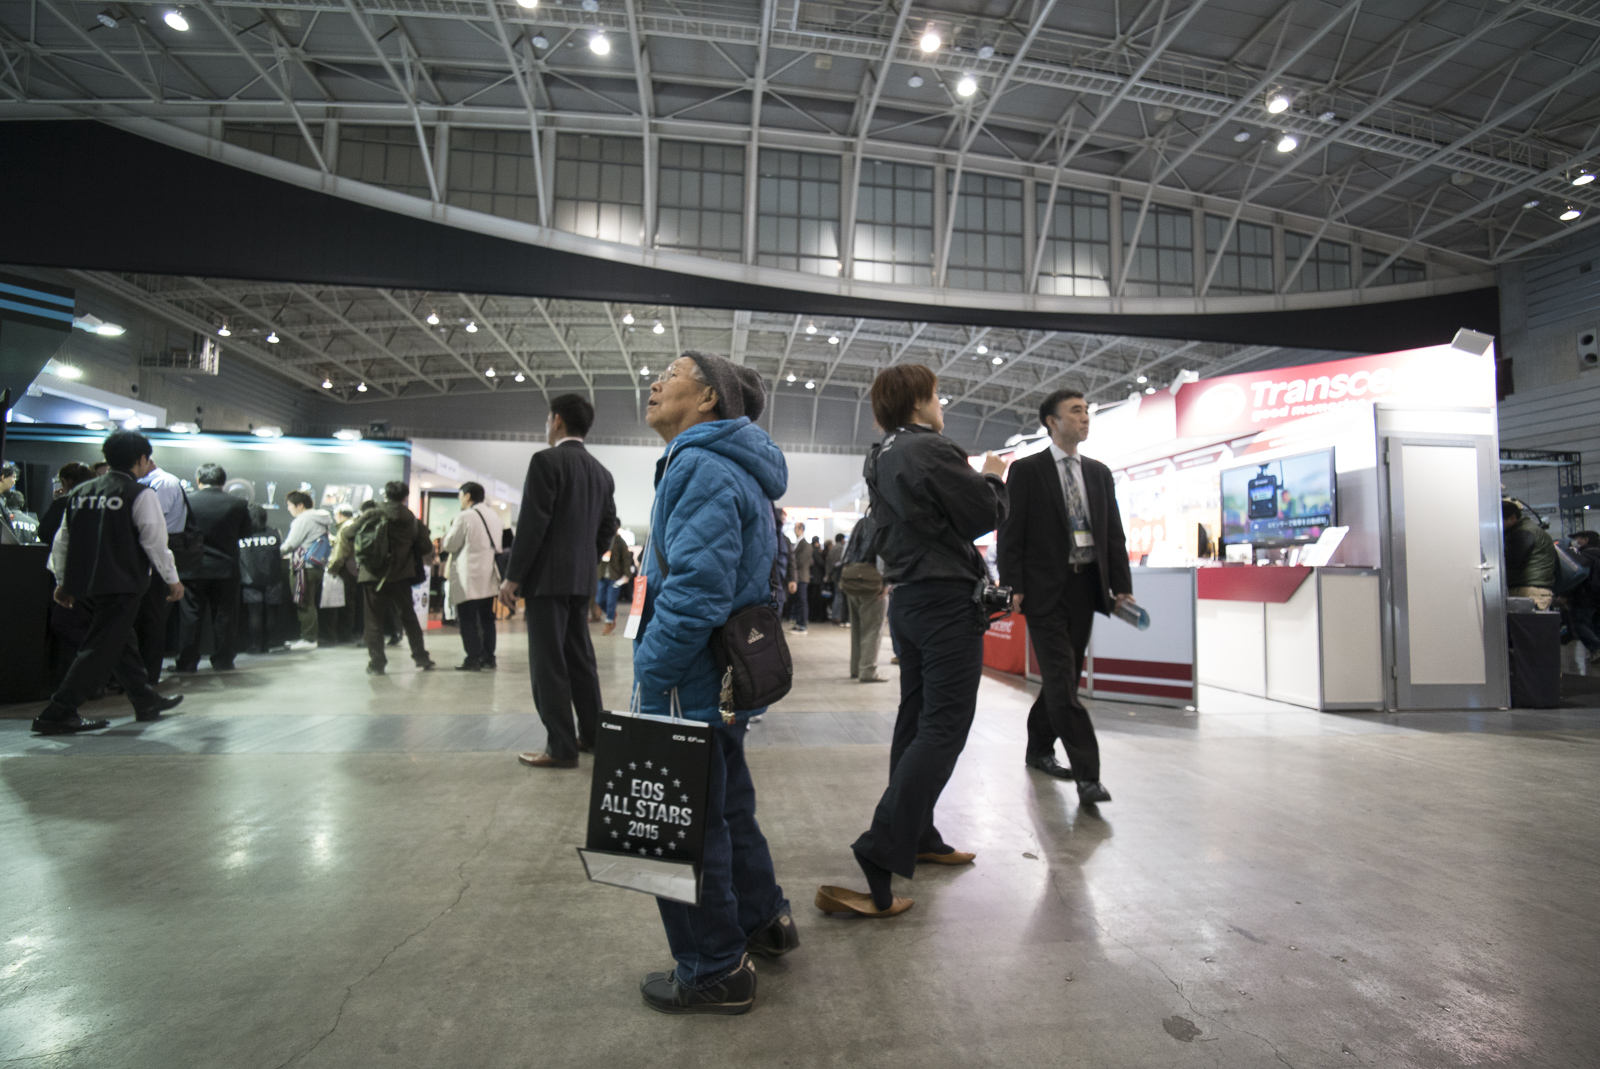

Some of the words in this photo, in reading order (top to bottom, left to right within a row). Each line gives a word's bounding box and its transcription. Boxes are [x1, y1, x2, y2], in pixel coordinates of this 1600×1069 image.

[71, 495, 123, 510] LYTRO
[11, 520, 37, 532] YTRO
[239, 535, 277, 549] LYTRO
[631, 778, 665, 802] EOS
[600, 793, 632, 816] ALL
[635, 799, 693, 827] STARS
[627, 820, 659, 841] 2015
